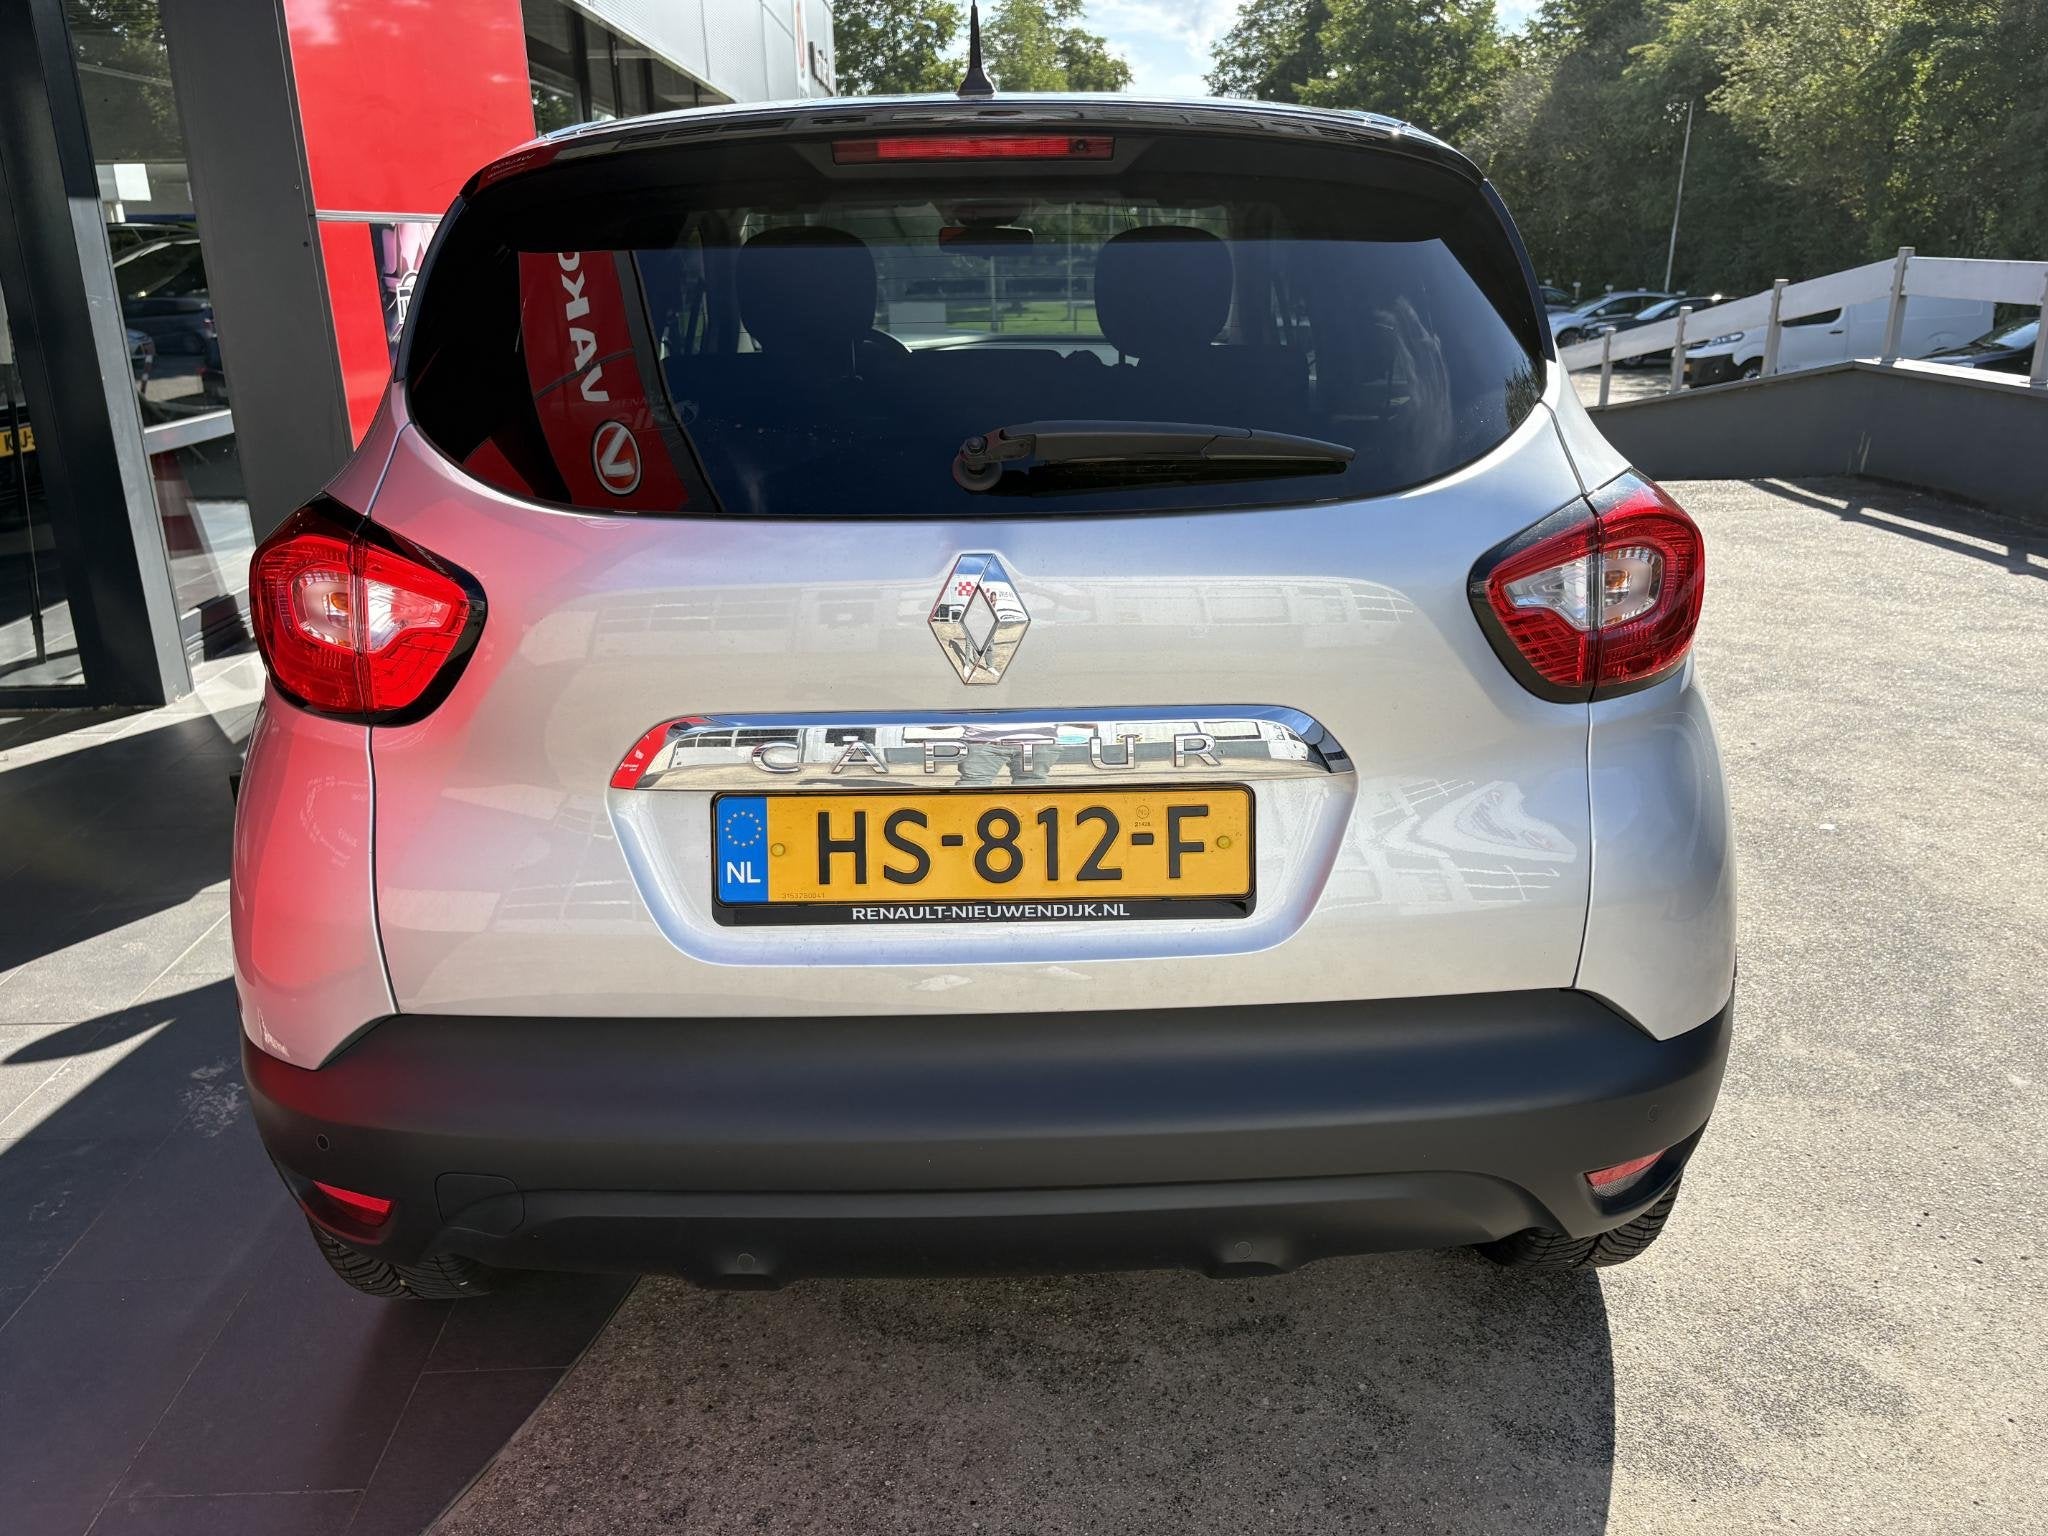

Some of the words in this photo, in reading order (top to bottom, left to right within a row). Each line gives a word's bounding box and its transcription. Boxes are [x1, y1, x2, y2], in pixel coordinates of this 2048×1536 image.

[752, 733, 1221, 774] CAPTUR
[817, 805, 1209, 884] HS-812-F
[727, 861, 761, 884] NL
[852, 903, 1130, 920] RENAULT-NIEUWENDIJK.NL
